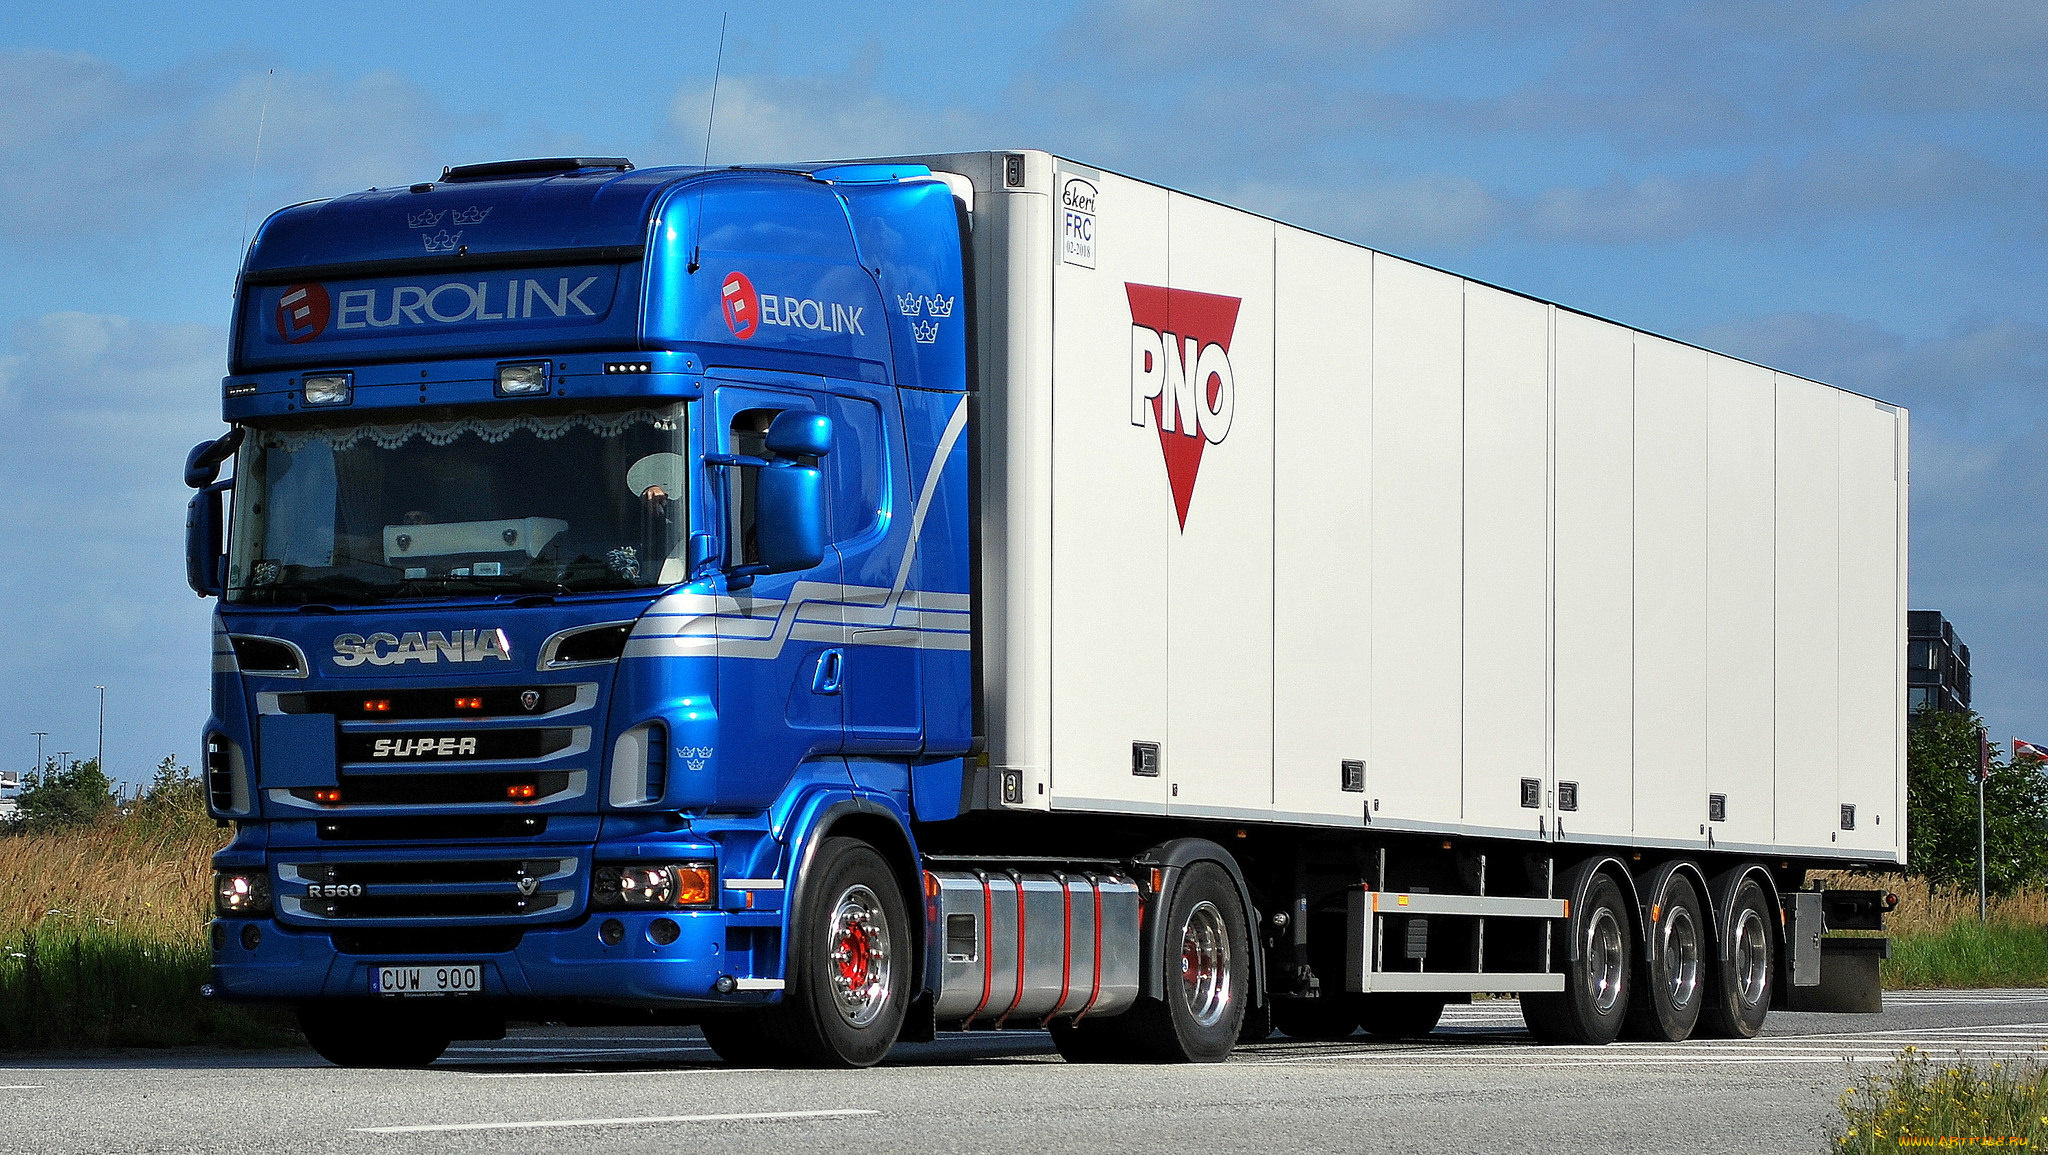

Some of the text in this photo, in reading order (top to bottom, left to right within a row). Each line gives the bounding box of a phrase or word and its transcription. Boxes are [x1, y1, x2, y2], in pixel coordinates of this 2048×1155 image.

[1066, 213, 1091, 241] FRC
[1066, 240, 1091, 258] 02-2018
[336, 276, 598, 329] EUROLINK
[760, 294, 865, 336] EUROLINK
[1131, 321, 1234, 445] PNO
[332, 628, 511, 667] SCANIA
[373, 737, 476, 757] SUPER
[309, 884, 362, 898] R 560
[382, 968, 476, 990] CUW 900
